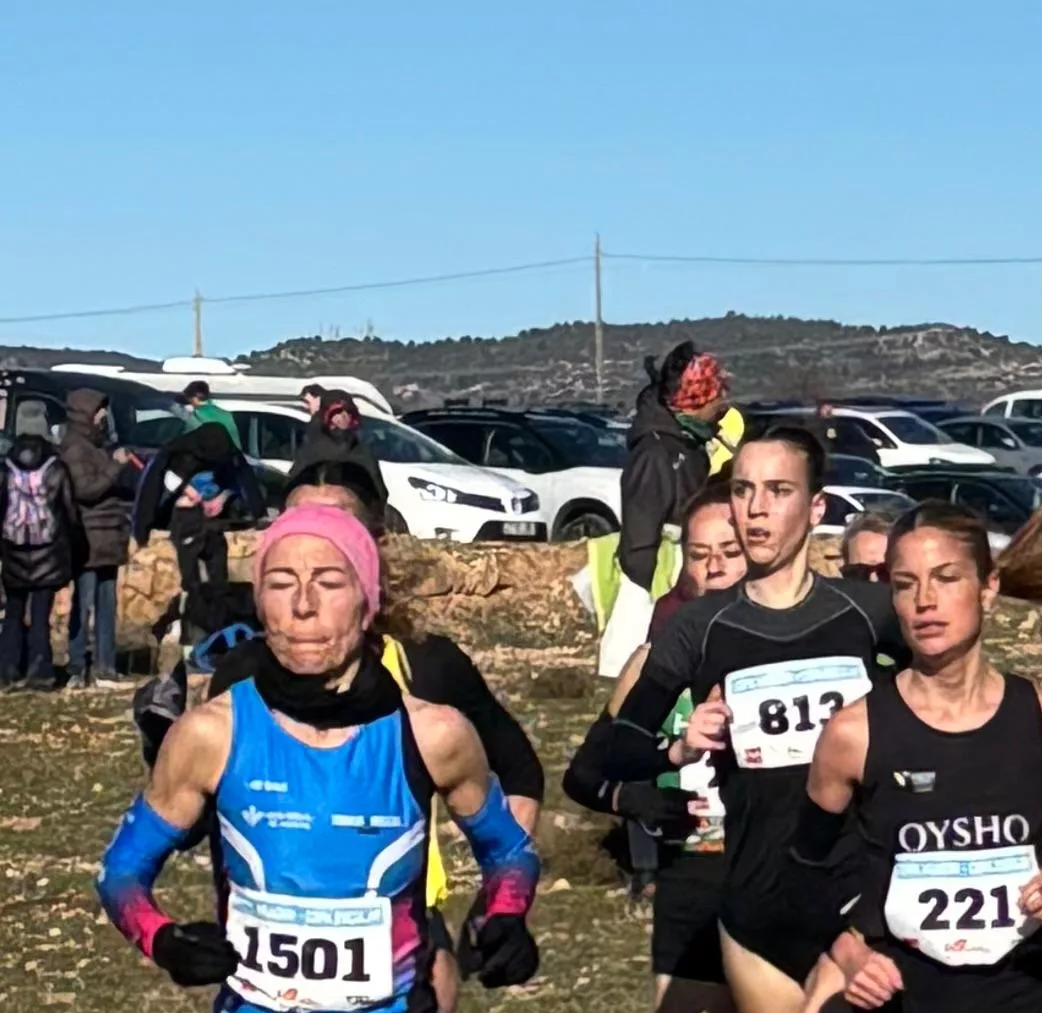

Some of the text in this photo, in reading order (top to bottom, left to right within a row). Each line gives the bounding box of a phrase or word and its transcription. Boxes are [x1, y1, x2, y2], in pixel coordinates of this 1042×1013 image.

[898, 814, 1029, 852] OYSHO
[918, 884, 1015, 930] 221
[243, 926, 371, 982] 1501
